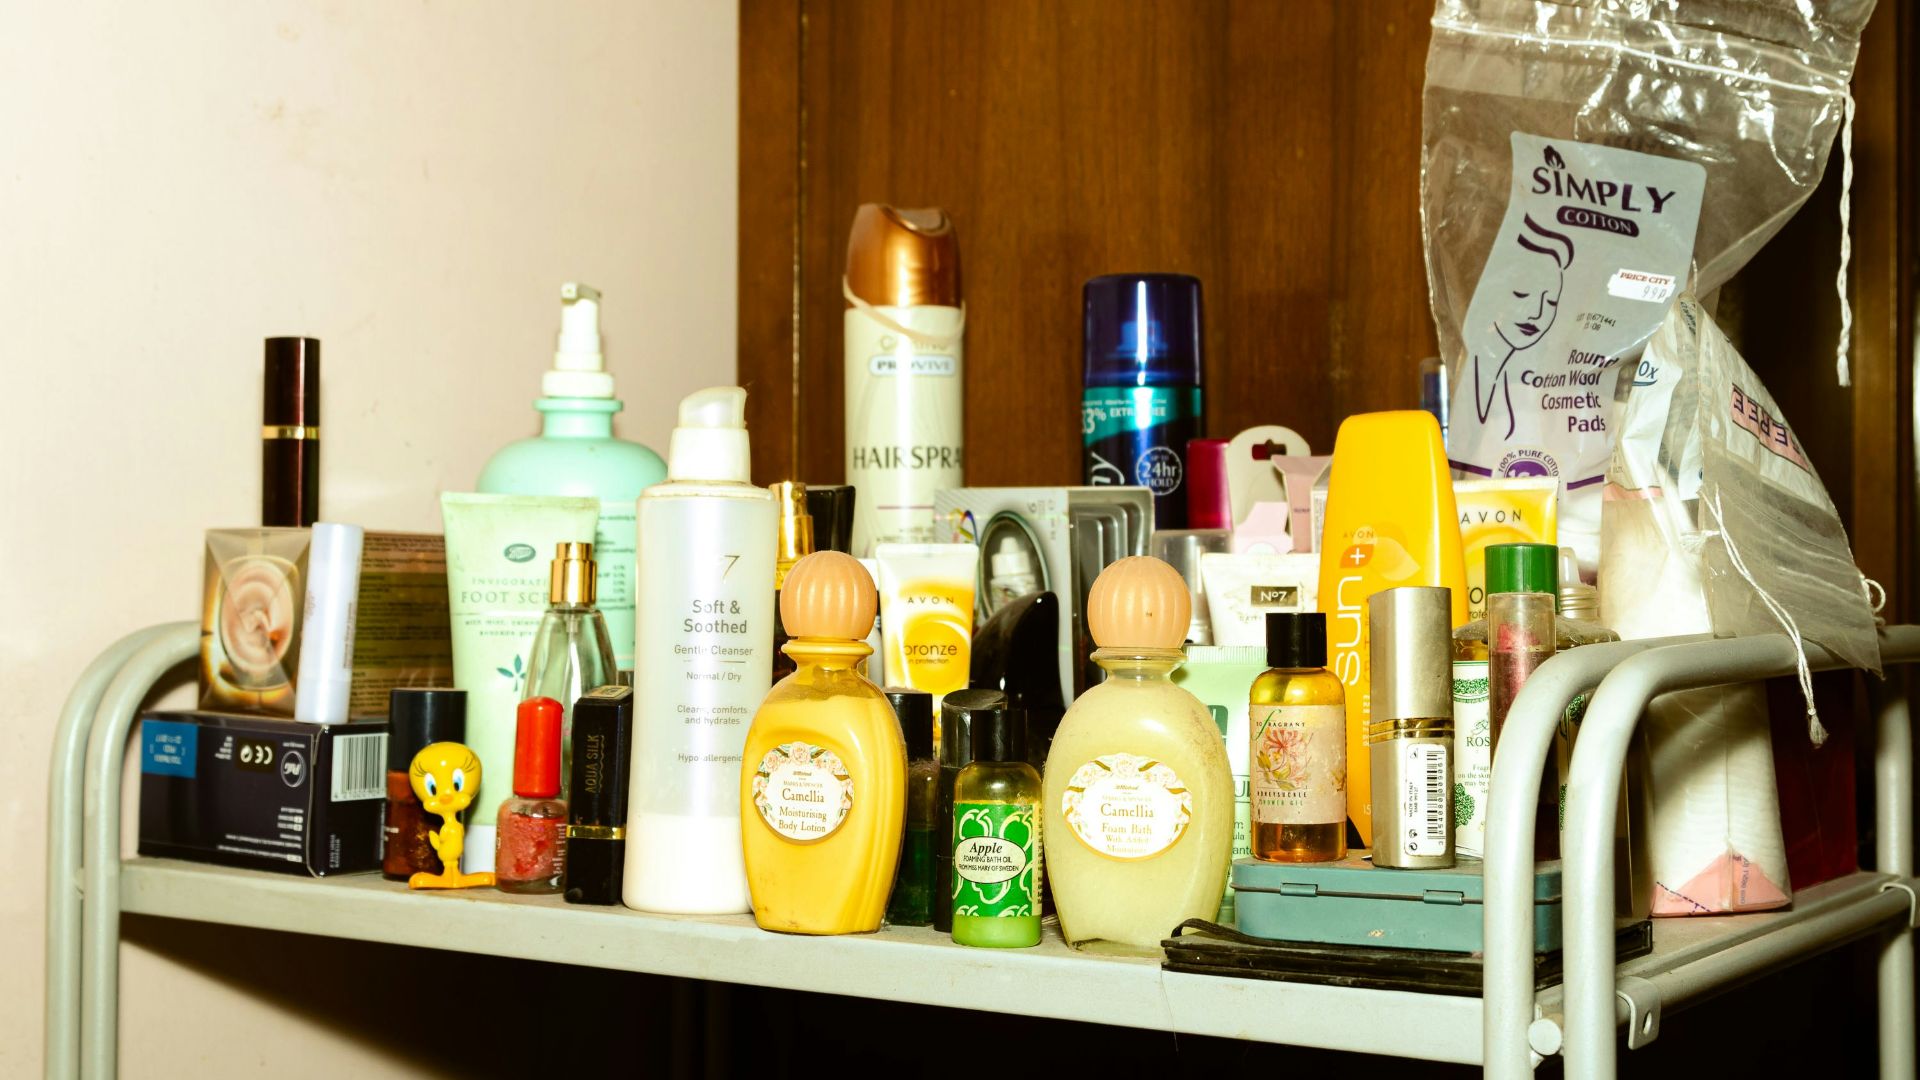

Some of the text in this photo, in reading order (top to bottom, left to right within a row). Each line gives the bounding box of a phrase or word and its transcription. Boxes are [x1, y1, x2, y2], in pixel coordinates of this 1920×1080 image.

[1531, 166, 1676, 214] SIMPLY
[1563, 208, 1635, 235] COTTON
[1620, 271, 1671, 285] PRICE CITY
[1521, 369, 1566, 388] Cotton
[1541, 391, 1601, 410] Cosmetic
[1567, 415, 1606, 433] Pads
[1498, 451, 1517, 473] 100%
[1518, 449, 1543, 458] PURE
[1141, 461, 1177, 478] 24hr
[1460, 508, 1523, 525] AVON
[1342, 531, 1375, 539] AVON
[461, 591, 510, 604] FOOT
[907, 596, 955, 605] AVON
[692, 599, 741, 615] Soft &
[683, 618, 748, 634] Soothed
[711, 645, 754, 656] Cleanser
[686, 671, 720, 681] Normal
[727, 672, 742, 682] Dry
[711, 705, 748, 714] comforts
[684, 716, 741, 726] and hydrates
[584, 734, 600, 793] AQUA SILK
[782, 788, 825, 803] Camellia
[779, 806, 827, 823] Moisturising
[1100, 802, 1154, 818] Camellia
[778, 819, 826, 834] Body Lotion
[1102, 822, 1152, 835] Foam Bath
[969, 842, 1003, 857] Apple
[963, 855, 986, 863] FOAMING
[986, 855, 1002, 863] BATH
